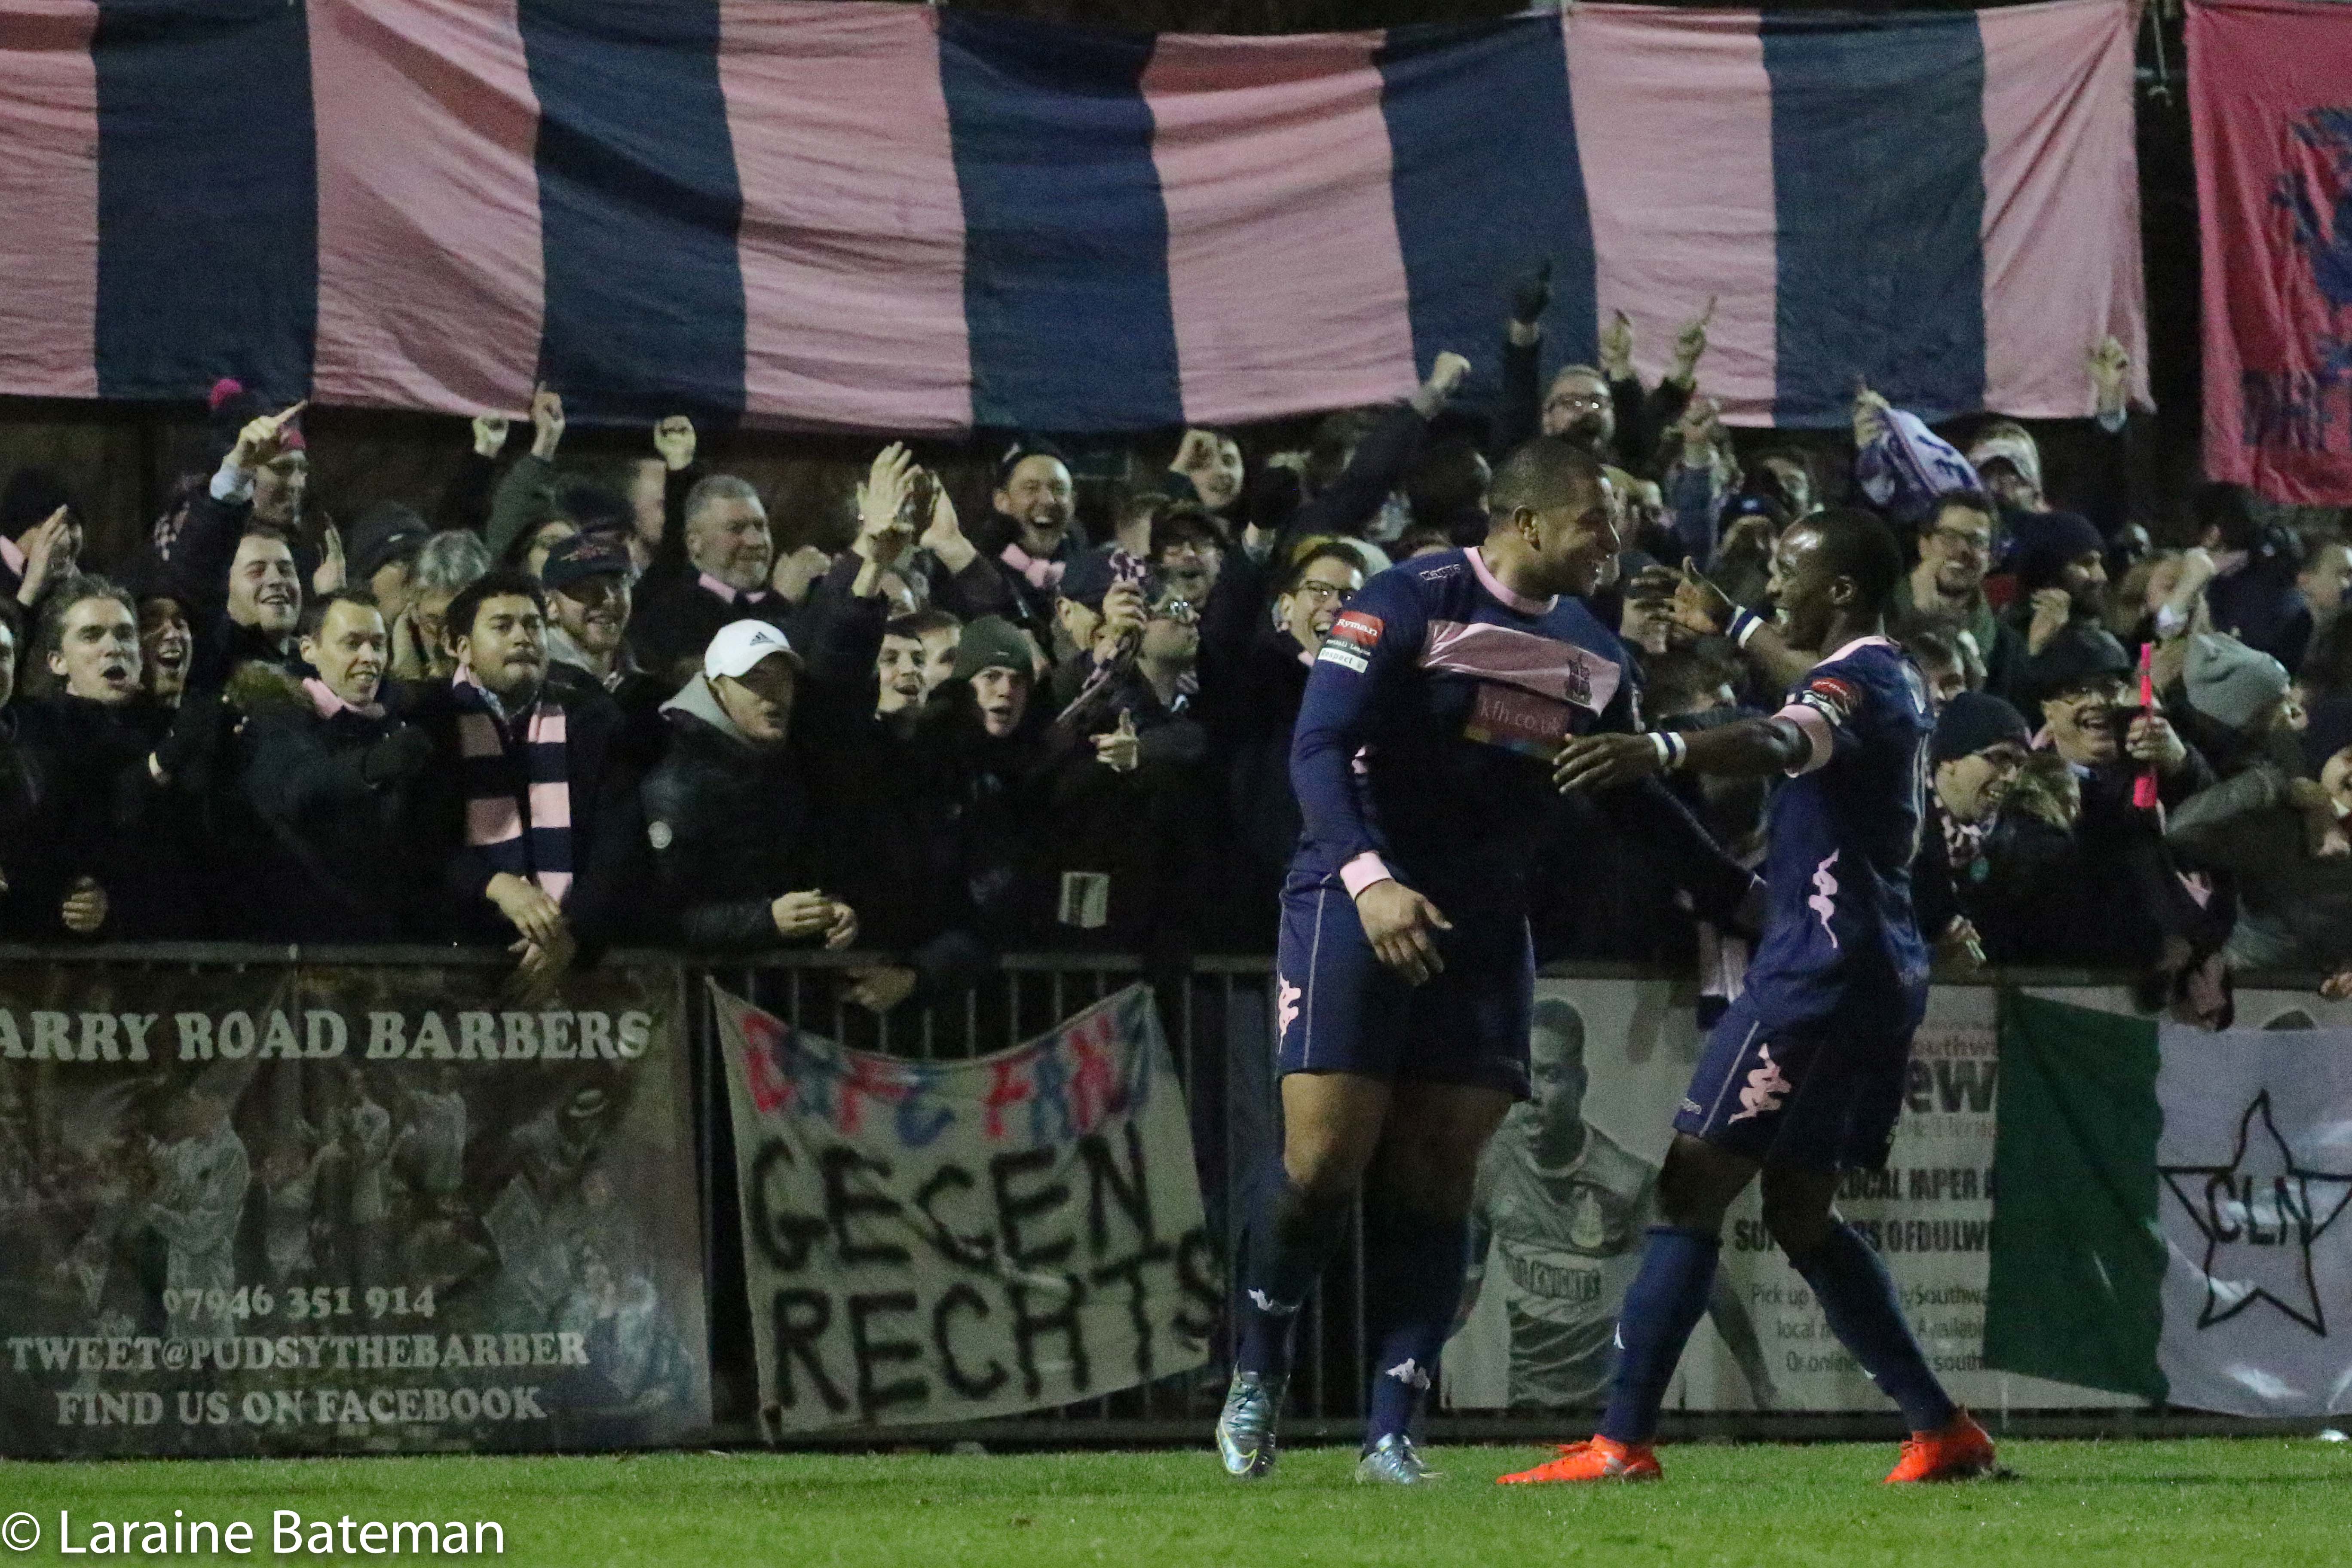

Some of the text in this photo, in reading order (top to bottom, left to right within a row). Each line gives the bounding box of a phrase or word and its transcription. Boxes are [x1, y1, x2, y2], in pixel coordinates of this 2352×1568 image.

[1336, 619, 1377, 636] Ryman
[1320, 649, 1353, 665] Respect
[1481, 697, 1560, 737] kfh.co.uk
[0, 1008, 652, 1060] ARRY ROAD BARBERS
[163, 1285, 436, 1321] 07946 351 914
[1752, 1284, 1781, 1305] Pick
[1789, 1289, 1809, 1309] up
[773, 1224, 1226, 1426] RECHTS
[1778, 1319, 1815, 1338] local
[7, 1333, 590, 1371] TWEET@PUDSYTHEBARBER
[55, 1386, 548, 1425] FIND US ON FACEBOOK
